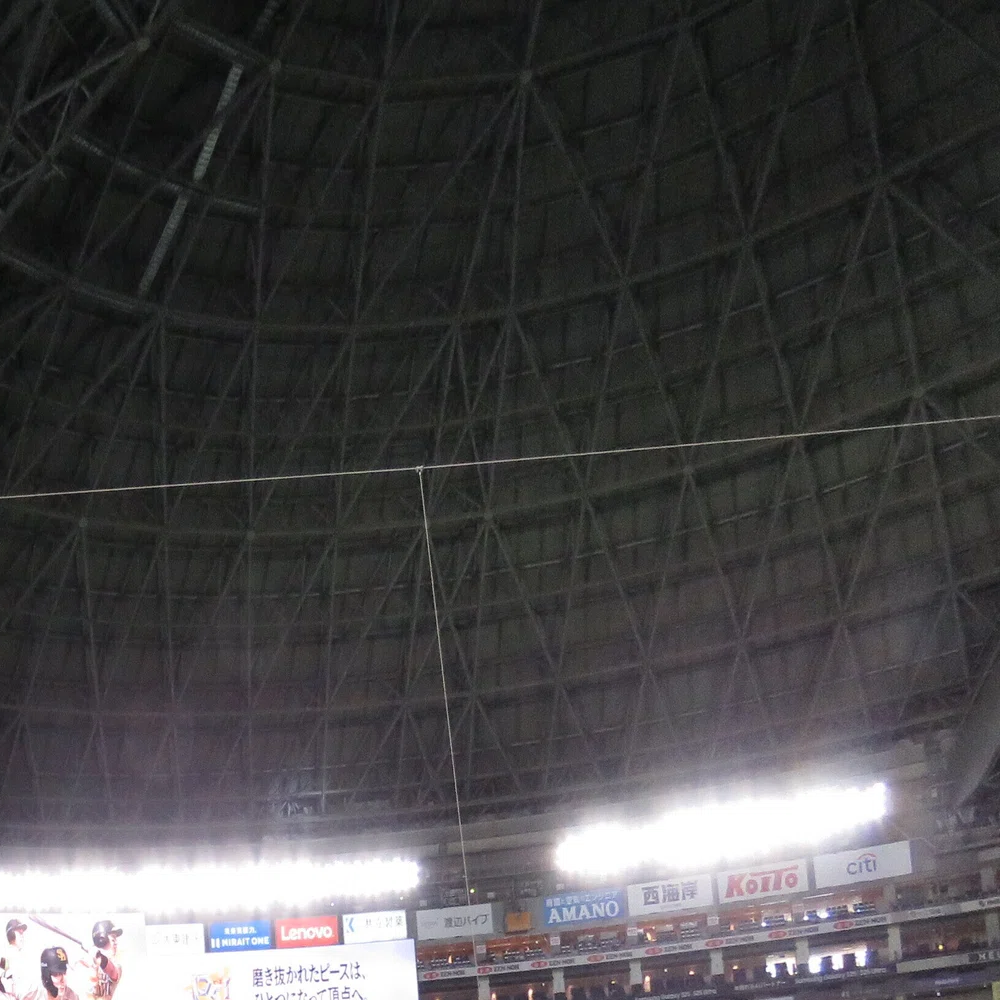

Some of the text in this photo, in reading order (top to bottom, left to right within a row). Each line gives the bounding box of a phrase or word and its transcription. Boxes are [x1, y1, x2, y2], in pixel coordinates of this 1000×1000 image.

[847, 853, 877, 875] citi
[641, 879, 698, 906] 西海岸
[548, 900, 620, 924] AMANO
[222, 935, 270, 947] MIRAIT ONE
[280, 925, 335, 940] Lenovo
[252, 961, 366, 987] 磨き抜かれたピースは、
